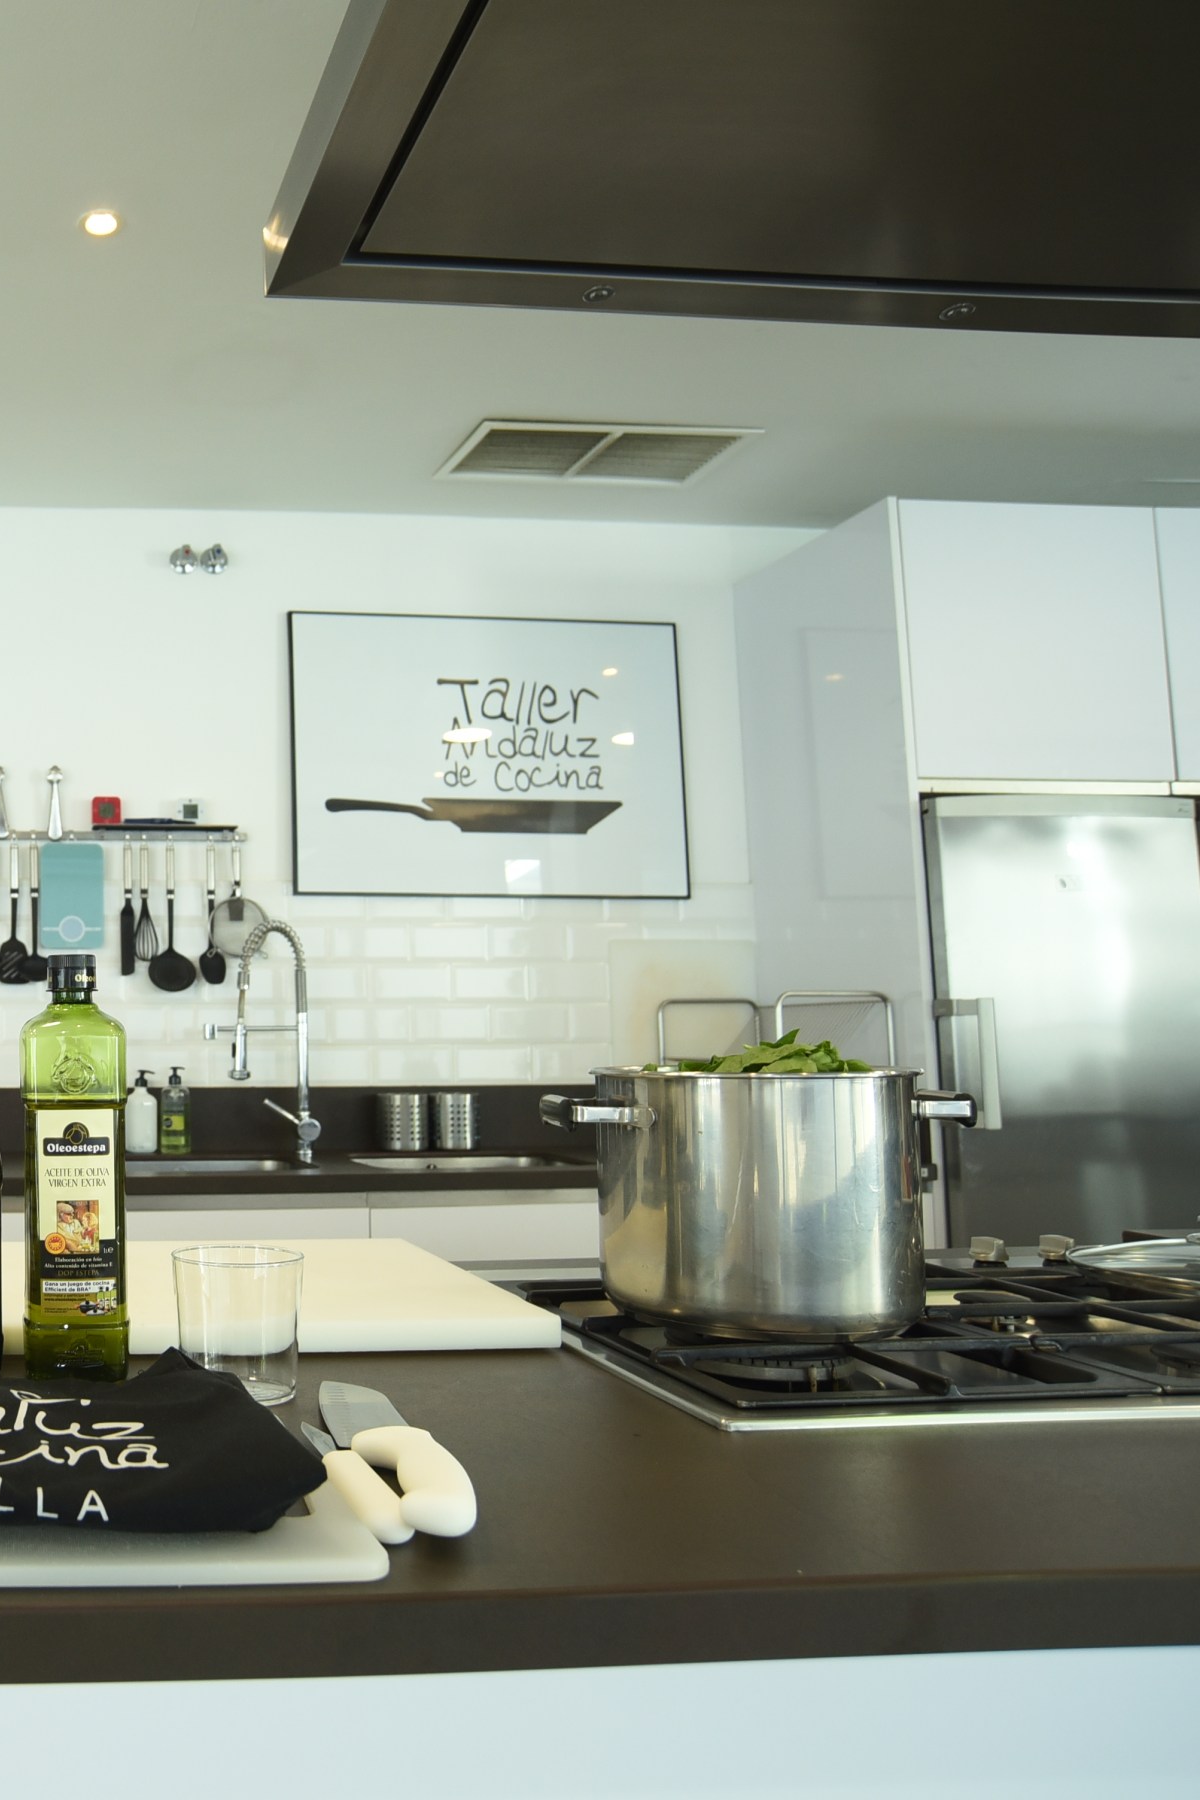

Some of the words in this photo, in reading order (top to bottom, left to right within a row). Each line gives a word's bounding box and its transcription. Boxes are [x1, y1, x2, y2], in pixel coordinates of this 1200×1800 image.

[436, 678, 600, 725] Taller
[443, 762, 478, 788] de
[494, 761, 605, 792] Cocina
[46, 1143, 107, 1154] Oleoestepa
[44, 1168, 72, 1177] ACEITE
[74, 1168, 85, 1177] DE
[86, 1167, 110, 1176] OLIVA
[48, 1179, 78, 1188] VIRGEN
[81, 1178, 107, 1187] EXTRA
